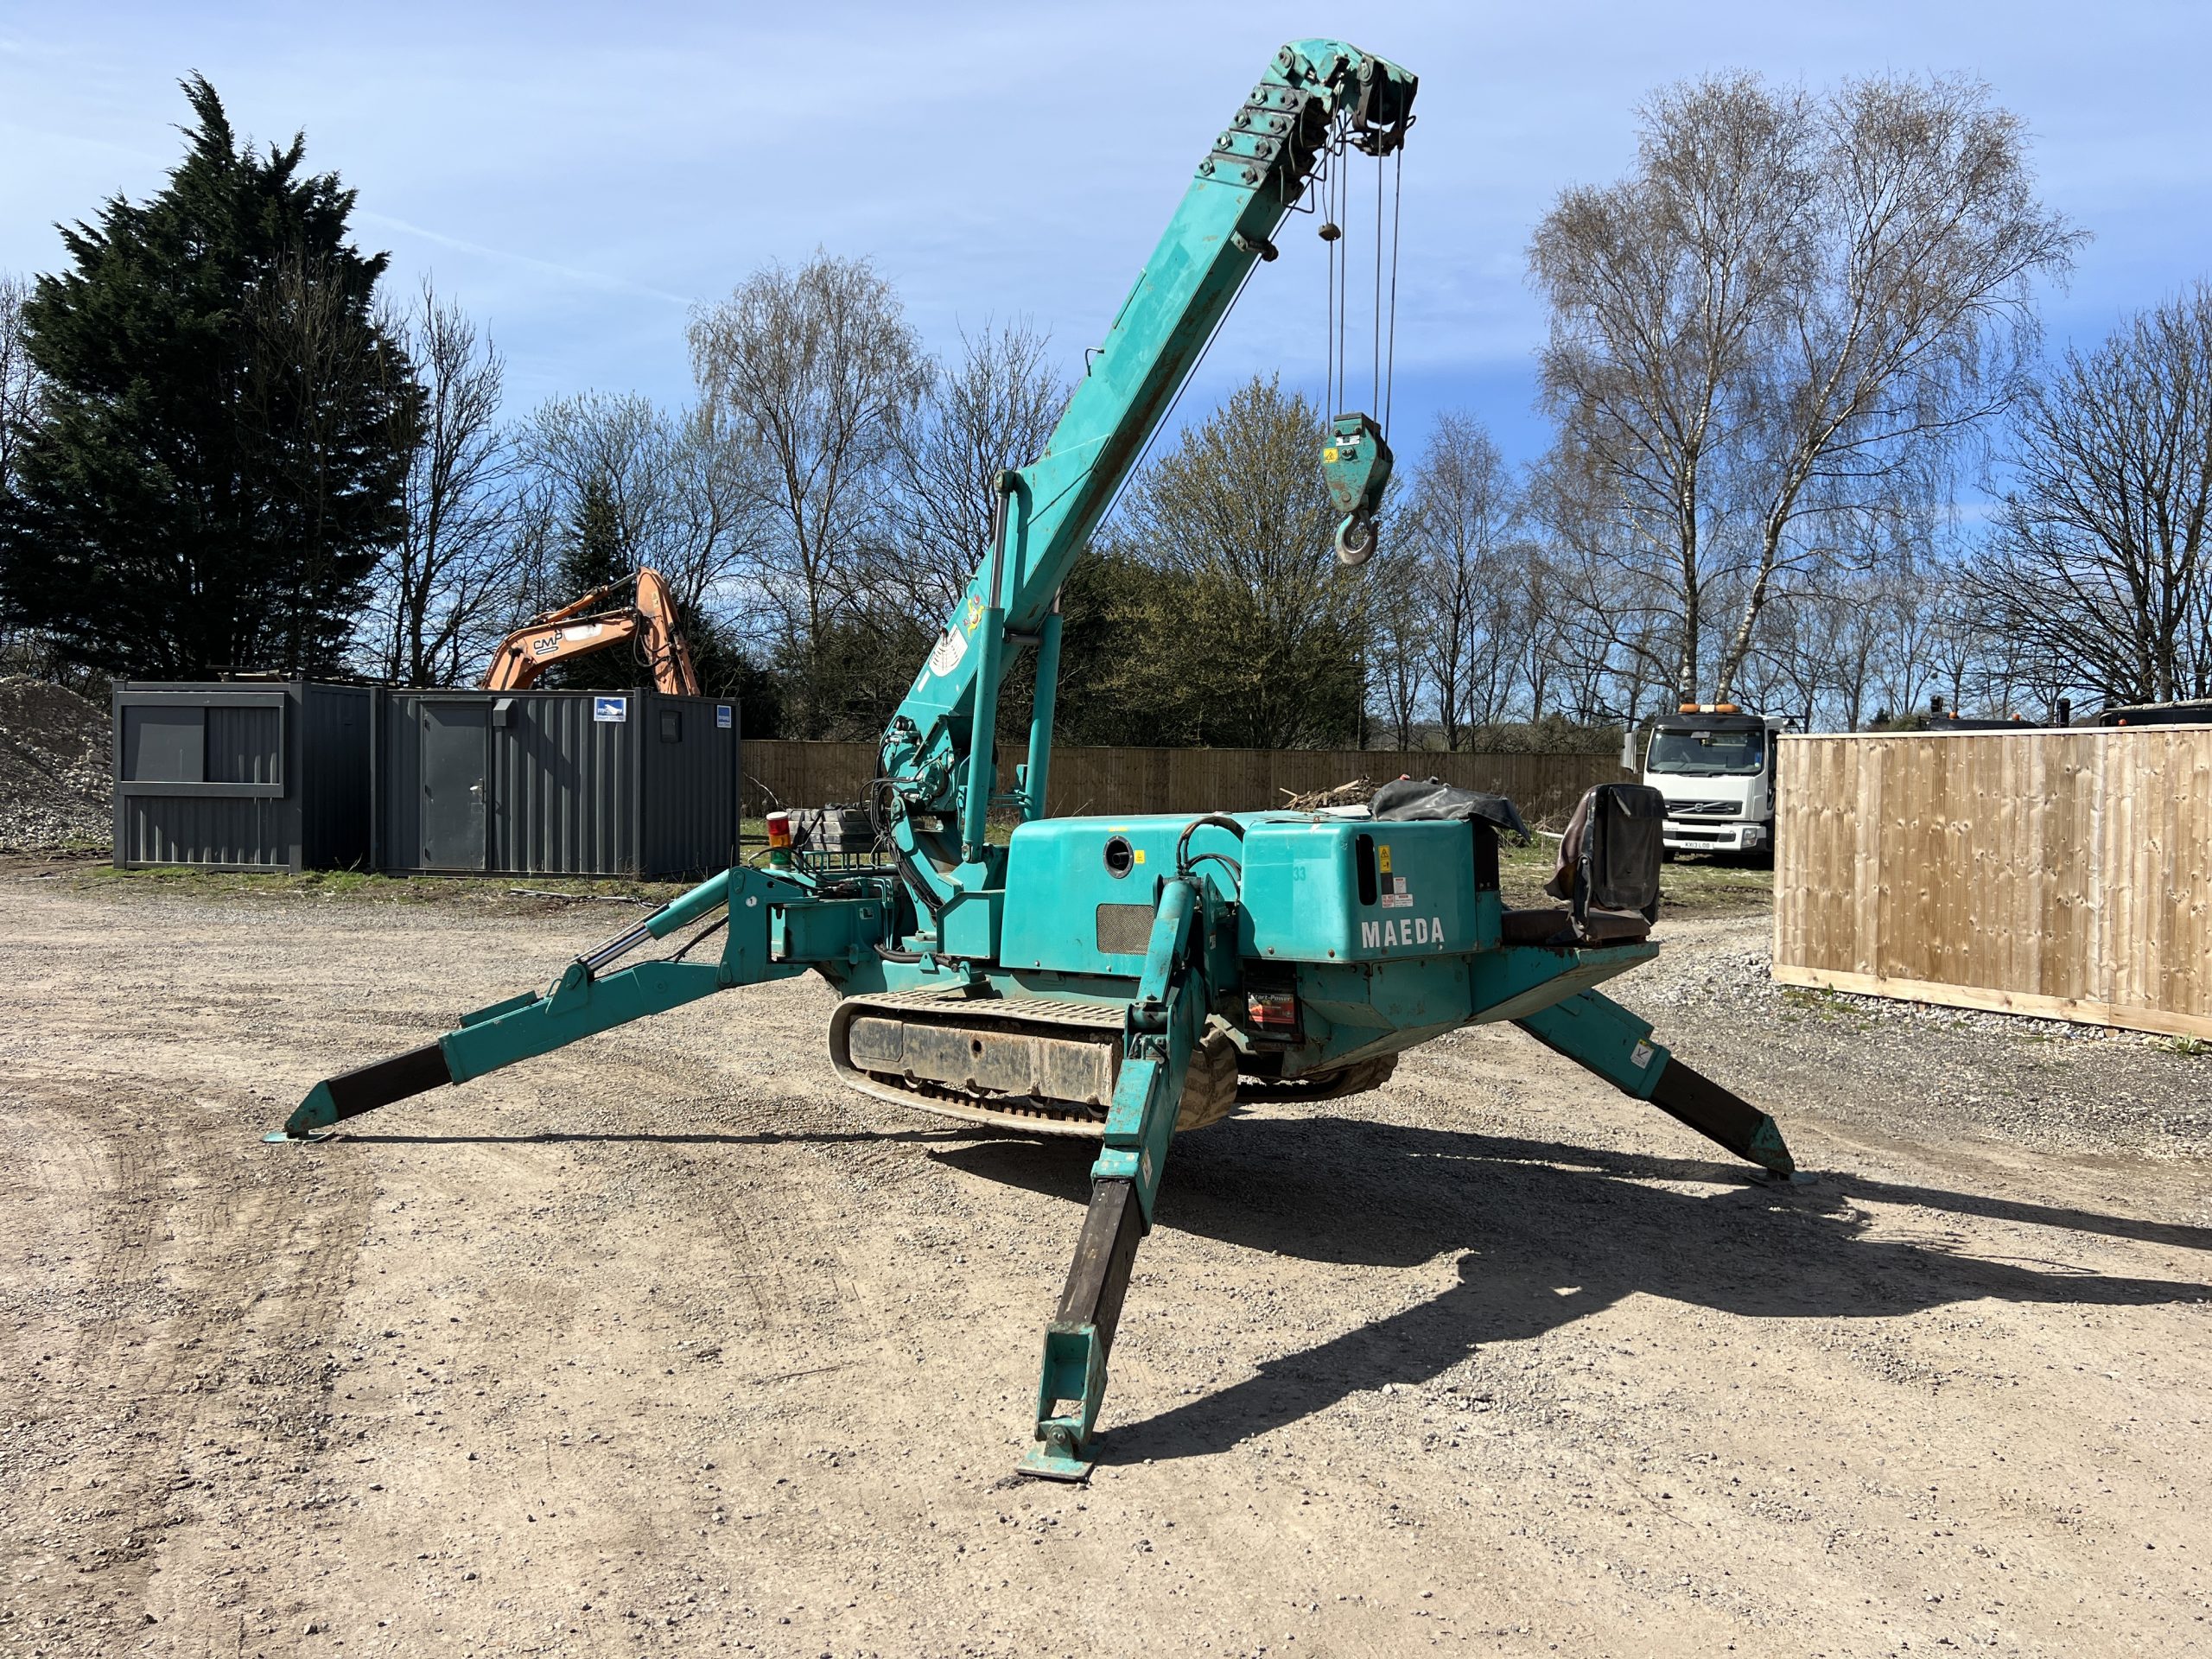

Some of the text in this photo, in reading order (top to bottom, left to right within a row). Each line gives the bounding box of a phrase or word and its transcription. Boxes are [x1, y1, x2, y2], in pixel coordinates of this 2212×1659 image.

[533, 632, 563, 650] CMP
[1294, 866, 1306, 881] 33
[1361, 917, 1445, 949] MAEDA
